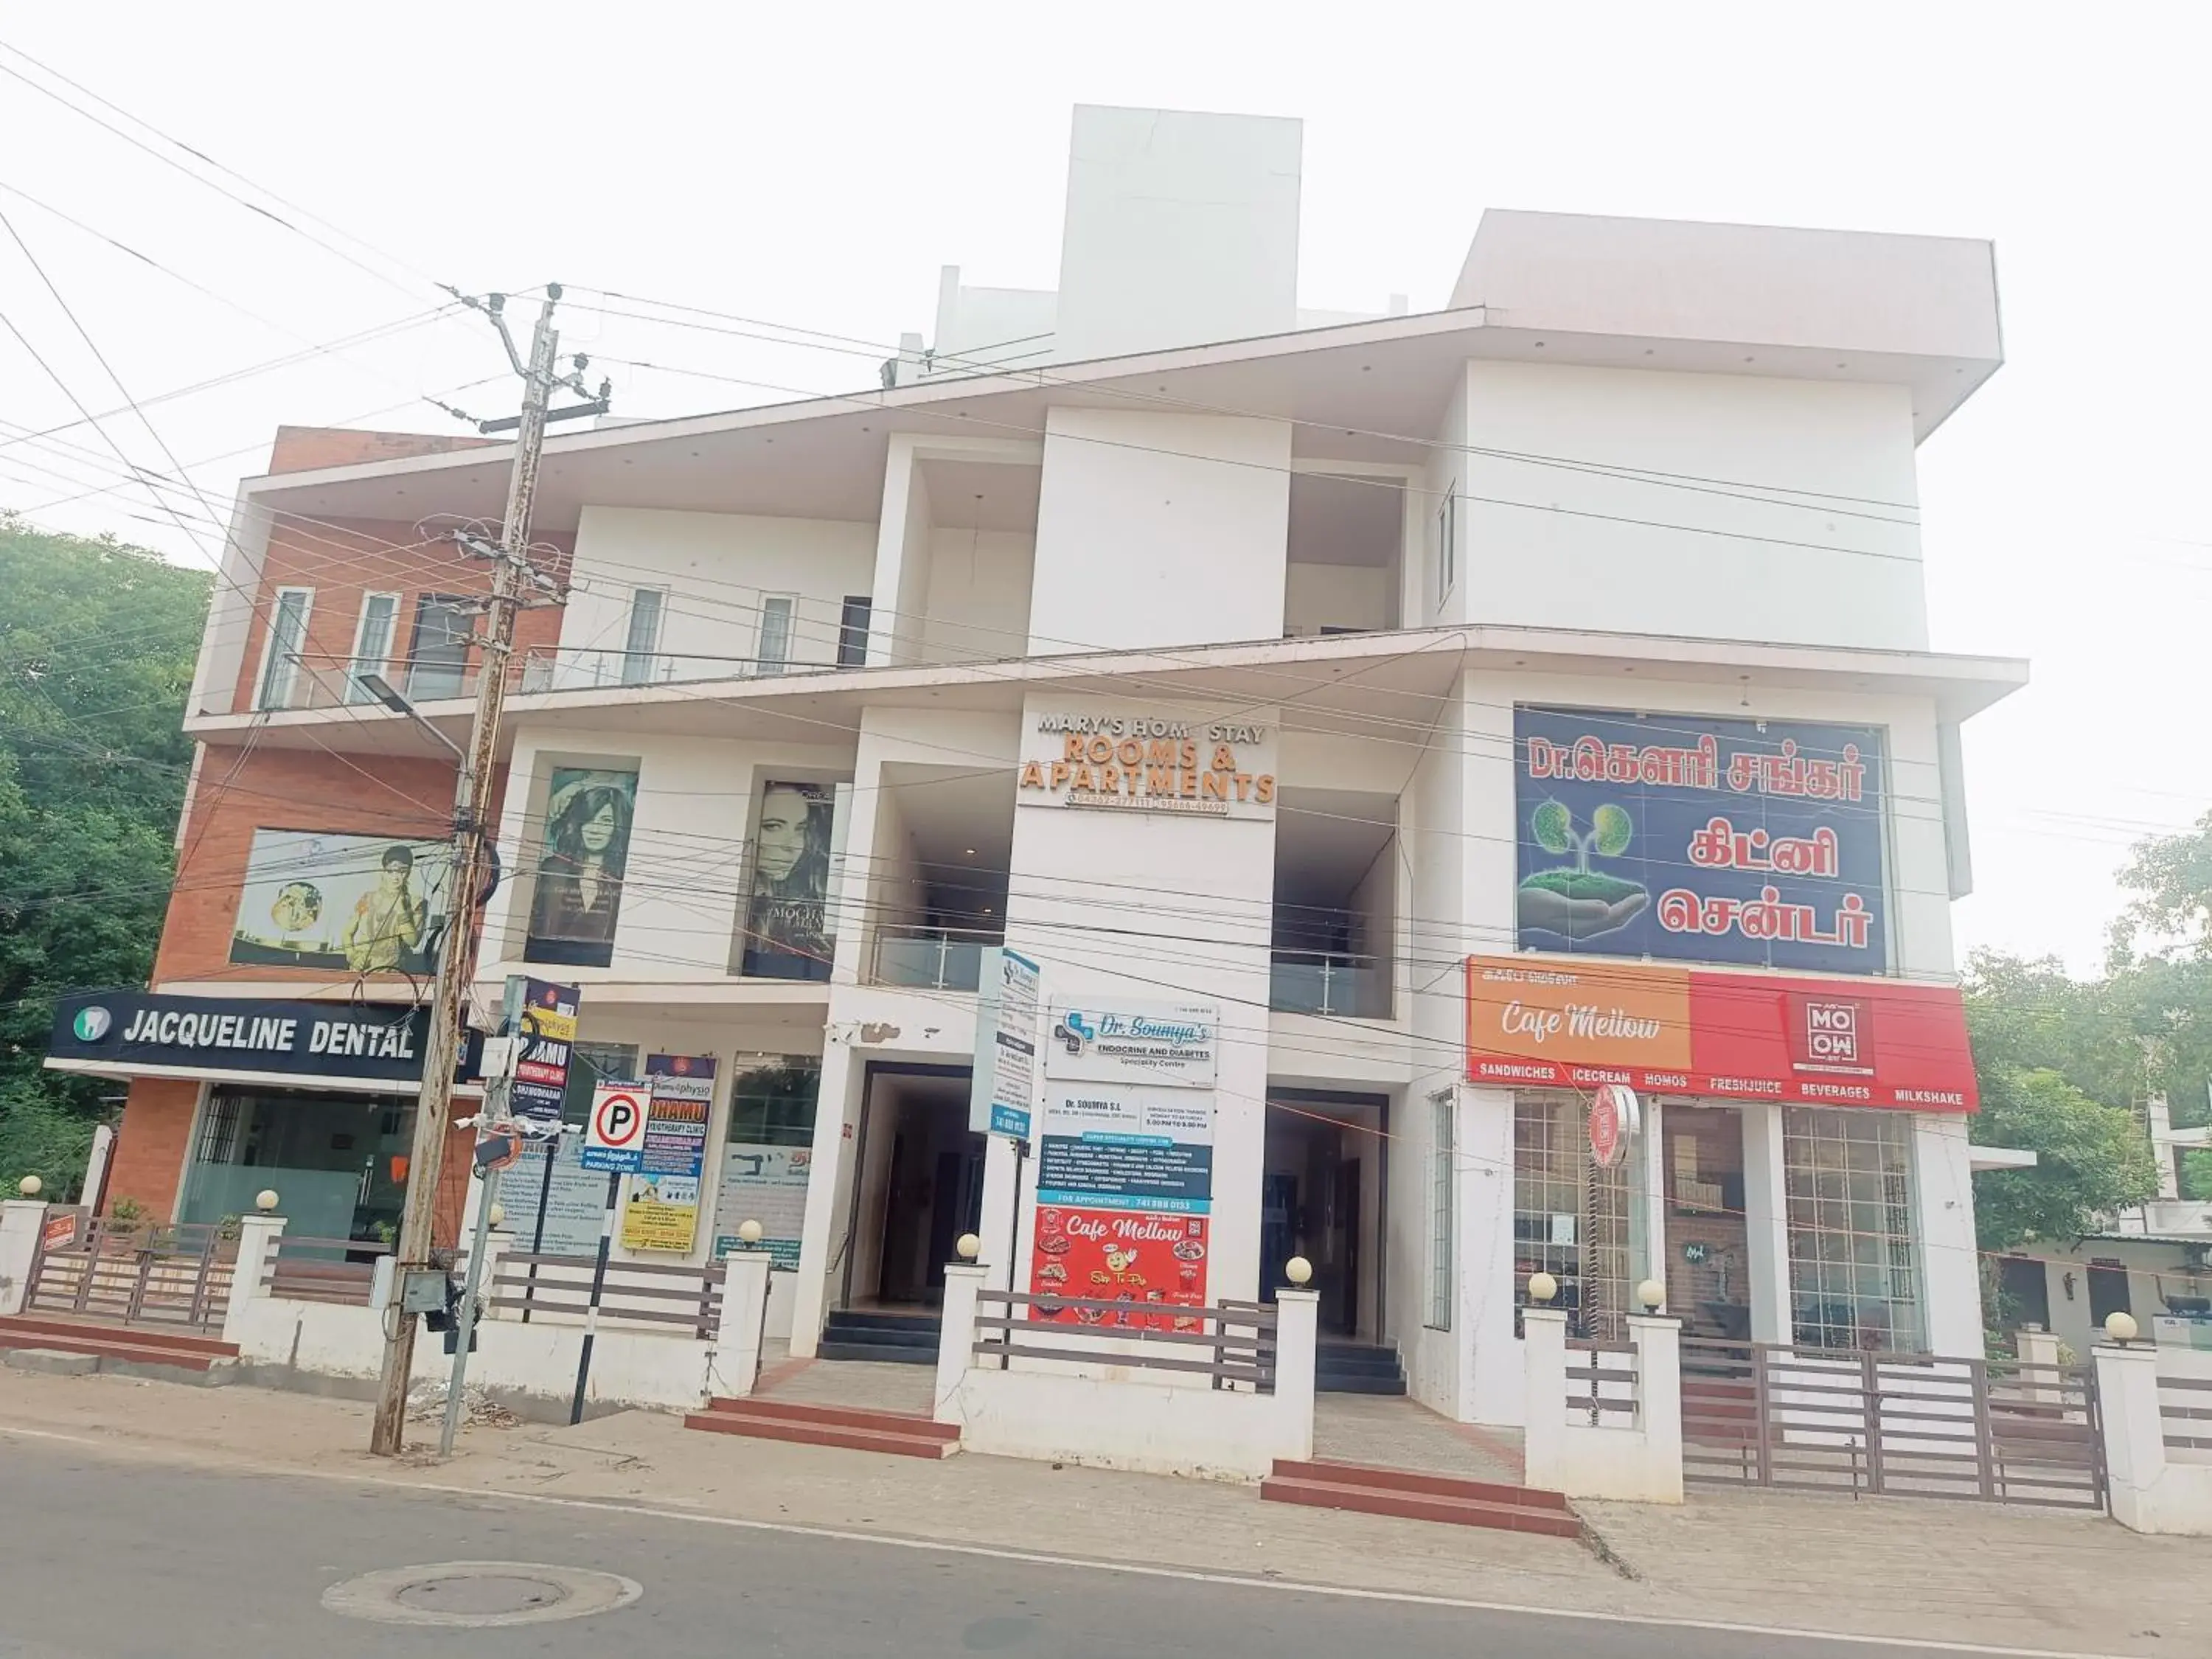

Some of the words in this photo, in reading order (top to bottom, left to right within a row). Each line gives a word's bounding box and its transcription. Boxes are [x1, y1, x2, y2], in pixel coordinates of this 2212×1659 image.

[1038, 713, 1125, 735] MARY'S
[1209, 724, 1265, 745] STAY
[1063, 731, 1199, 771] ROOMS
[1211, 743, 1237, 772] &
[1020, 760, 1276, 804] APARTMENTS
[1688, 816, 1839, 877] கிட்னி
[1657, 886, 1874, 948] சென்டர்
[124, 1009, 298, 1051] JACQUELINE
[308, 1021, 414, 1059] DENTAL
[1099, 1014, 1126, 1035] Dr.
[1130, 1015, 1209, 1044] Soumya's
[1501, 999, 1562, 1043] Cafe
[1564, 1004, 1660, 1040] Mellow
[1812, 1009, 1850, 1030] MO
[1098, 1044, 1147, 1054] ENDOCRINE
[1148, 1047, 1169, 1056] AND
[1169, 1048, 1210, 1059] DIABETES
[1479, 1062, 1556, 1079] SANDWICHES
[1572, 1068, 1631, 1085] ICECREAM
[1801, 1083, 1871, 1099] BEVERAGES
[1895, 1090, 1964, 1106] MILKSHAKE
[609, 1106, 632, 1135] P
[585, 1161, 616, 1171] PARKING
[616, 1163, 635, 1172] ZONE
[1066, 1214, 1108, 1242] Cafe
[1111, 1218, 1183, 1242] Mellow
